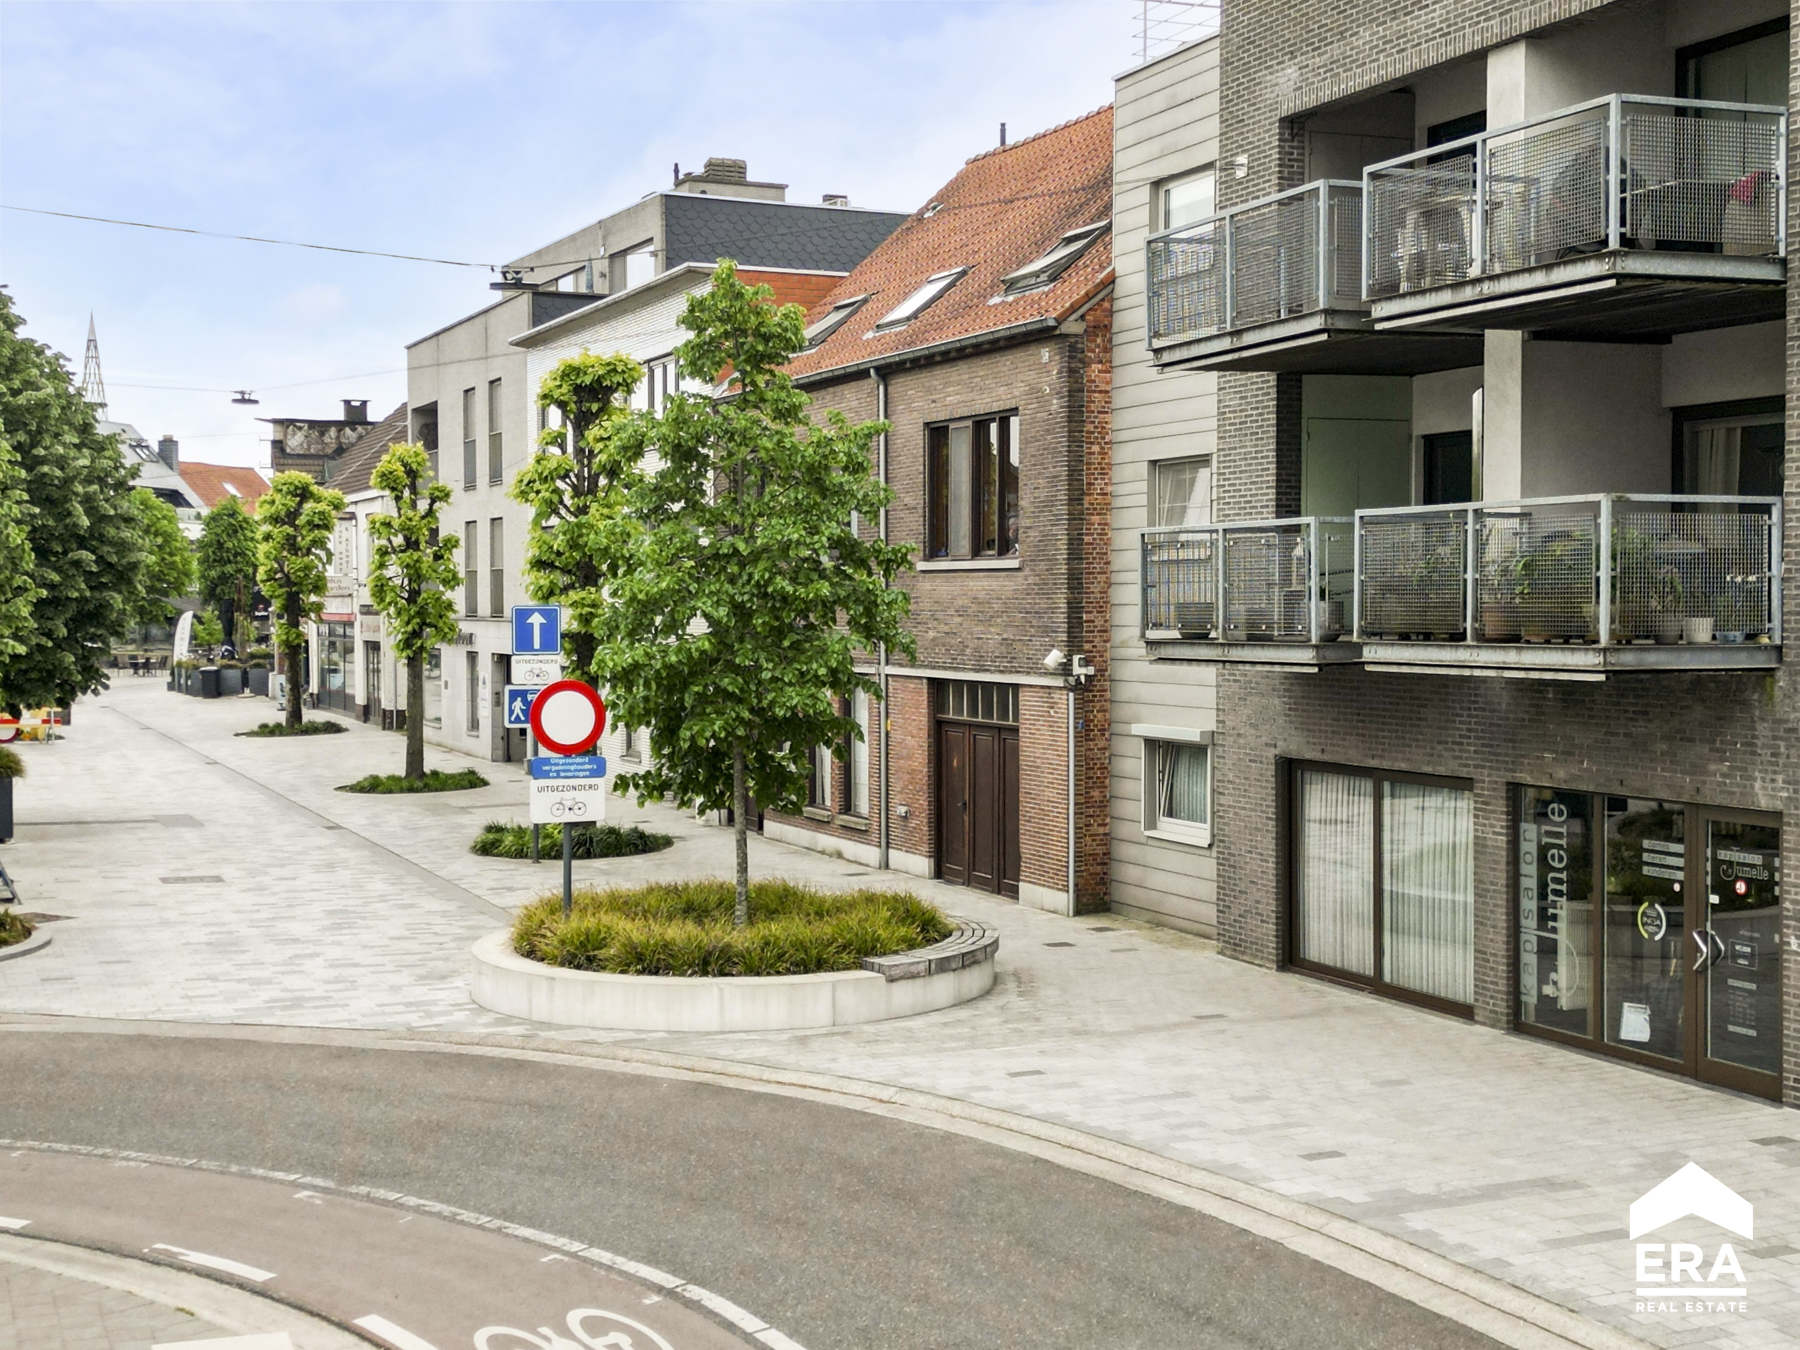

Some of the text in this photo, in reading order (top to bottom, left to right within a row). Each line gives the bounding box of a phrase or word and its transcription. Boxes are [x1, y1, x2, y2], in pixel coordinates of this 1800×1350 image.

[537, 784, 599, 793] UITGEZONDERD
[1718, 851, 1762, 864] kapsalon
[1720, 846, 1769, 880] Jumelle
[1520, 829, 1536, 999] kapsalon
